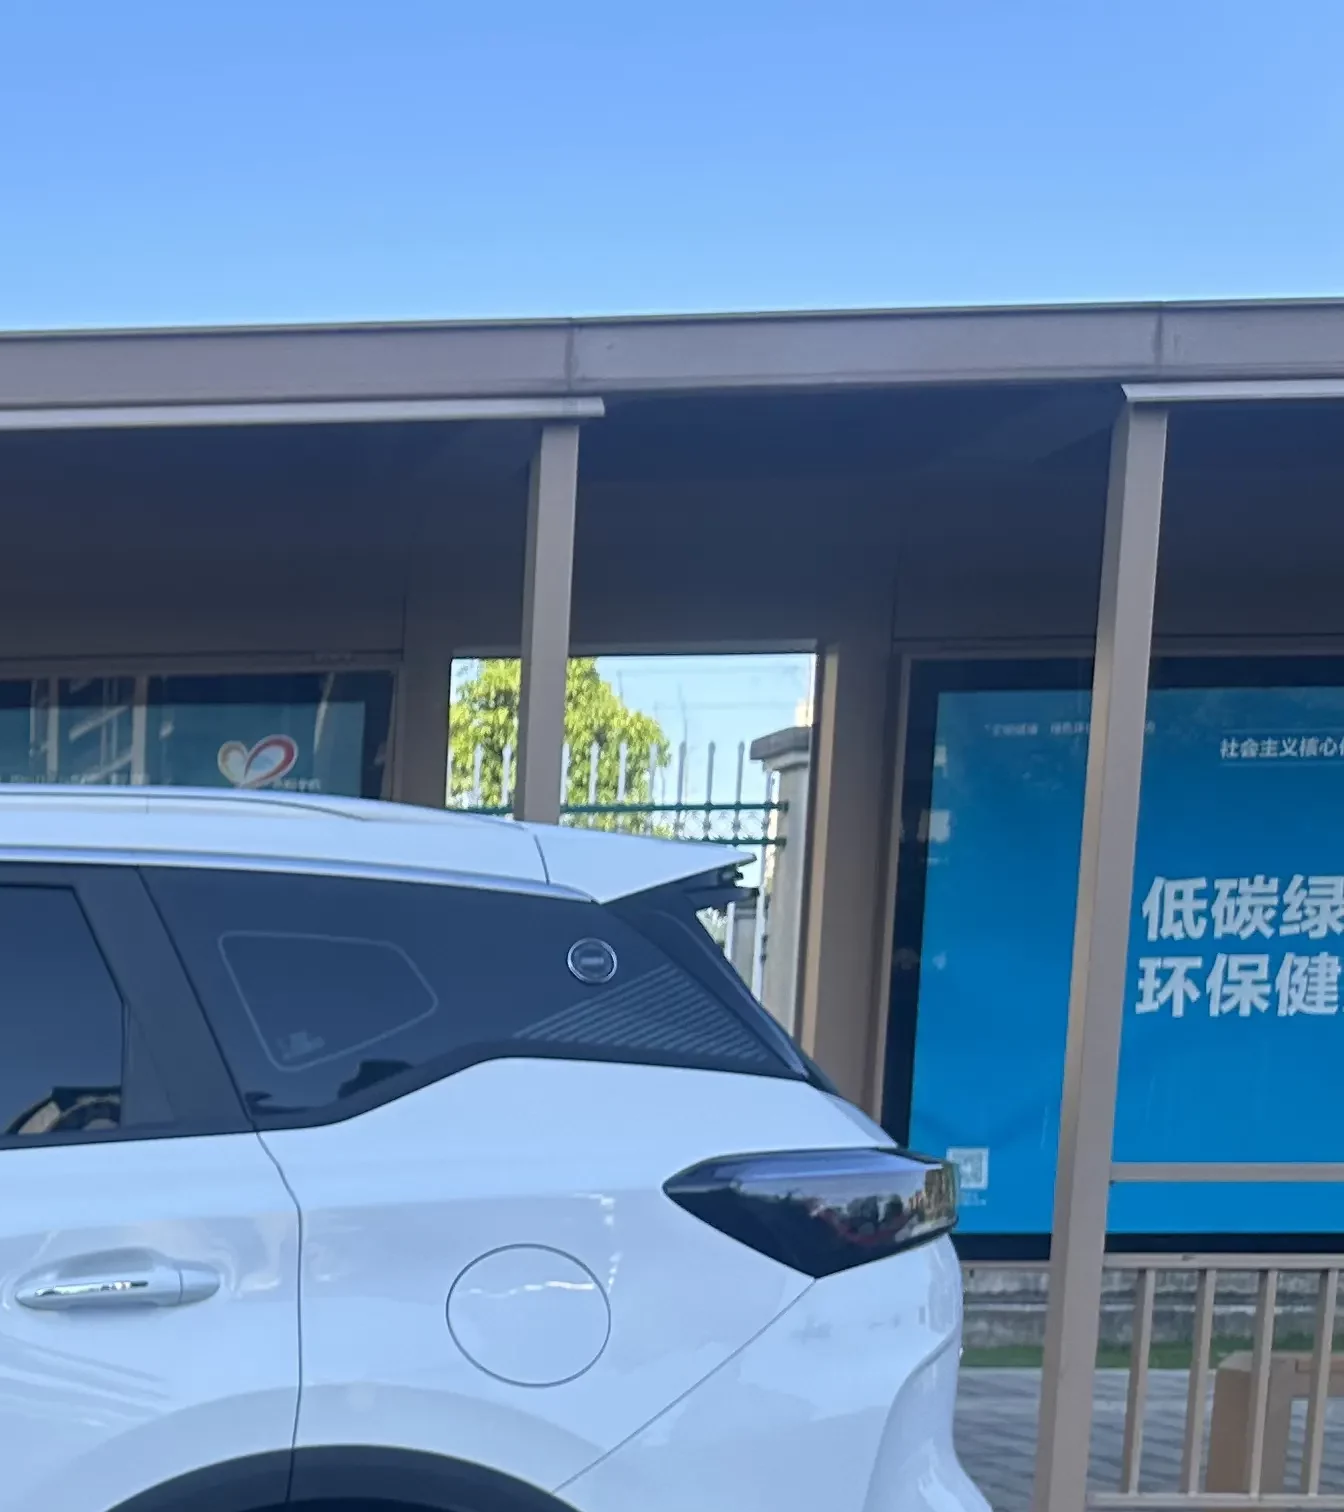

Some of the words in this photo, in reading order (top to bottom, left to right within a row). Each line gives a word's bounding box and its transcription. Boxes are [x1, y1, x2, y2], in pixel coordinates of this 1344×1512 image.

[1141, 873, 1344, 942] 低碳绿
[1135, 951, 1344, 1018] 环保健
